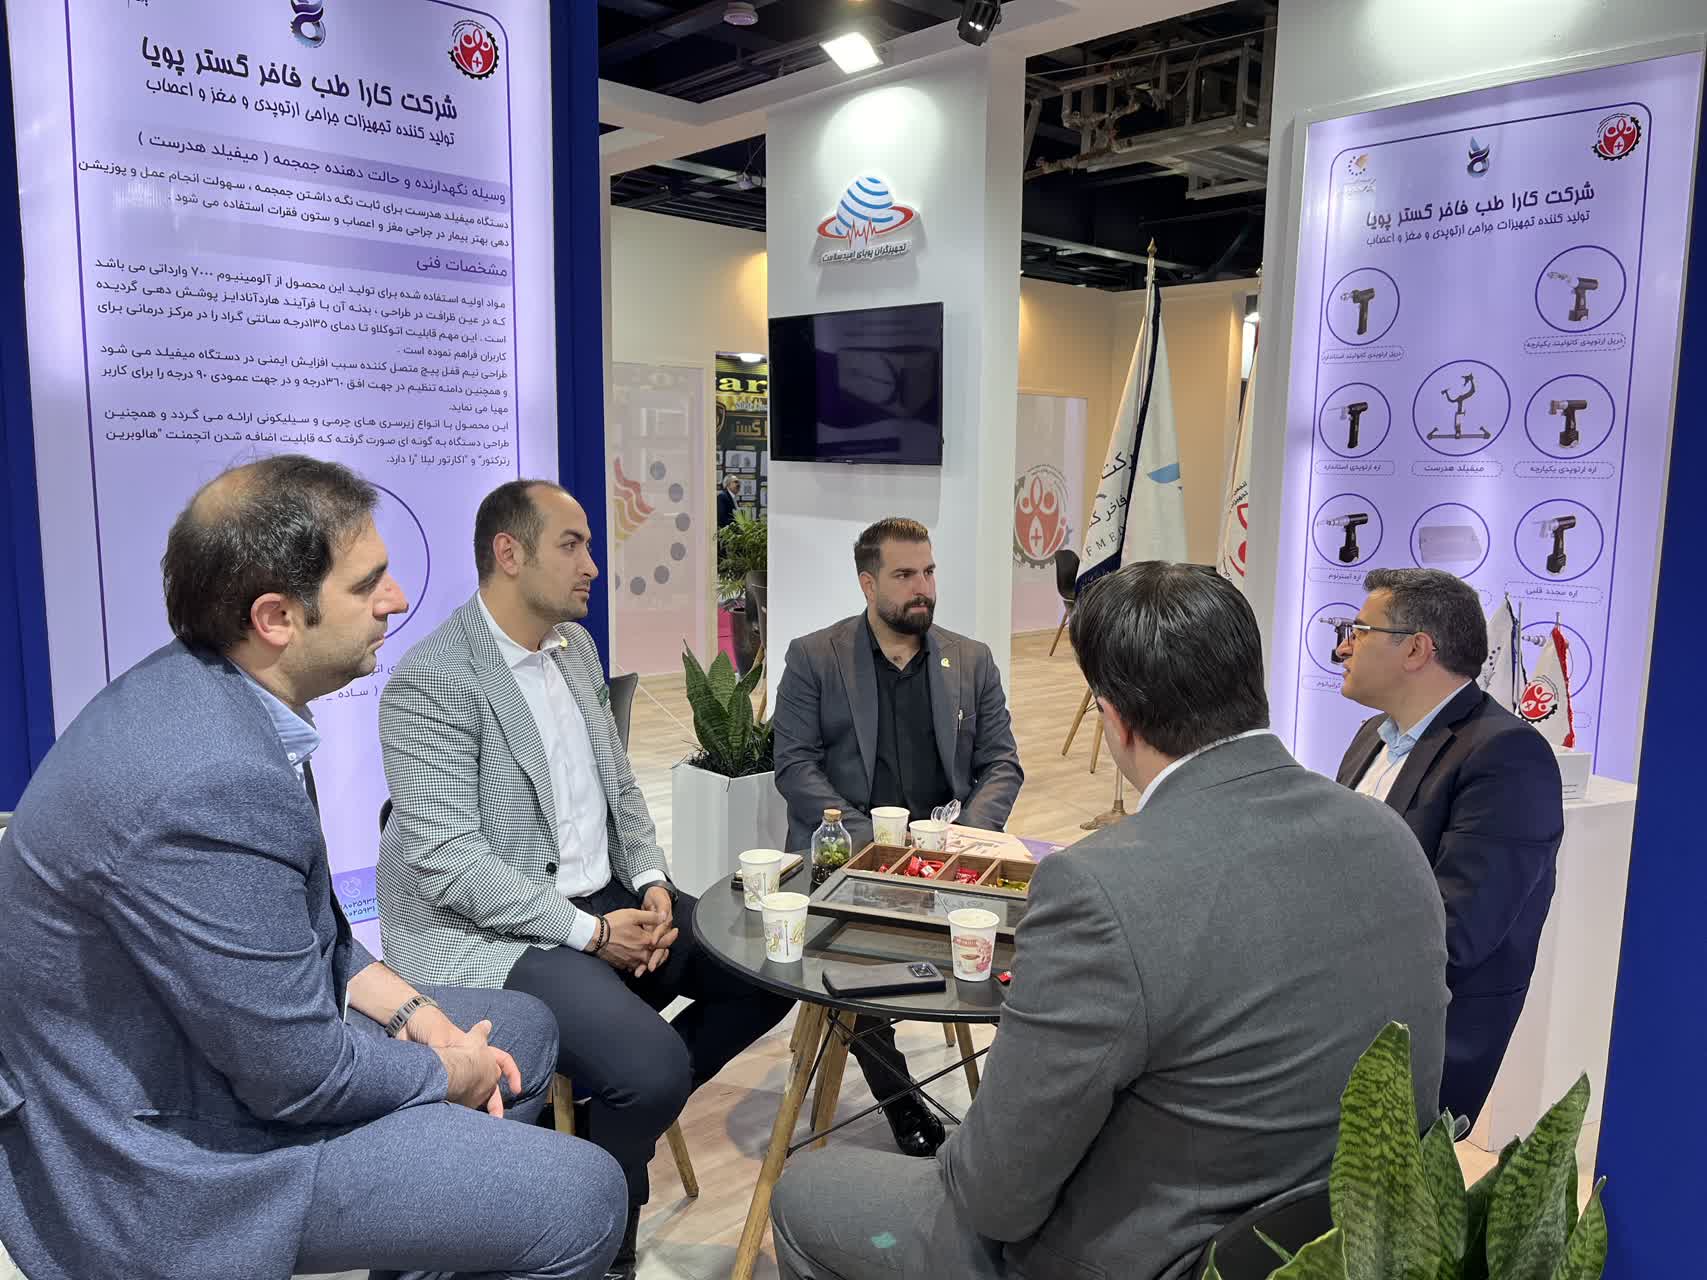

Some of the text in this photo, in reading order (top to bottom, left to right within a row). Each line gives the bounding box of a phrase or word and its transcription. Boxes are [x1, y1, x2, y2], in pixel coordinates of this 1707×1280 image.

[142, 35, 458, 121] شرکت کارا طب فاخر گستر پویا
[145, 77, 455, 147] تولید کننده تجهیزات جراحی ارتوپدی و مغز و اعصاب
[149, 136, 206, 153] هدرست
[211, 144, 258, 163] میفیلد
[273, 155, 320, 173] جمجمه
[325, 164, 363, 178] دهنده
[368, 171, 399, 183] حالت
[404, 179, 410, 189] و
[79, 160, 508, 229] دستگاه میفیلد هدرست برای ثابت نگه داشتن جمجمه سهولت انجام عمل و پوزیشن
[175, 194, 198, 205] شود
[472, 187, 505, 204] وسیله
[203, 200, 219, 208] می
[223, 200, 264, 212] استفاده
[1366, 180, 1595, 231] شرکت کارا طب فاخر گستر پویا
[268, 206, 297, 218] فقرات
[301, 212, 330, 222] ستون
[334, 217, 339, 225] و
[342, 217, 374, 228] اعصاب
[378, 224, 383, 232] و
[387, 222, 402, 232] مغز
[406, 227, 432, 238] جراحی
[1366, 210, 1591, 248] تولید کننده تجهیزات جراحی ارتوپدی و مغز و اعصاب
[448, 232, 468, 243] بیمار
[471, 235, 488, 246] بهتر
[95, 258, 124, 272] باشد
[128, 265, 145, 273] می
[416, 255, 508, 277] مشخصات فنی
[149, 264, 187, 278] وارداتی
[96, 280, 137, 293] گردیده
[275, 276, 282, 287] از
[286, 277, 325, 289] محصول
[143, 287, 171, 295] دهی
[329, 283, 344, 294] این
[348, 285, 375, 296] تولید
[378, 288, 397, 299] برای
[176, 287, 218, 302] پوشش
[400, 291, 421, 299] شده
[424, 293, 458, 303] استفاده
[283, 297, 315, 310] فرآیند
[320, 300, 329, 312] با
[333, 301, 346, 313] آن
[461, 298, 483, 308] اولیه
[487, 299, 505, 310] مواد
[349, 304, 371, 316] بدنه
[381, 308, 411, 319] طراحی
[414, 312, 423, 320] در
[426, 312, 455, 323] ظرافت
[493, 317, 506, 325] که
[481, 318, 490, 326] در
[428, 349, 451, 358] نموده
[454, 350, 477, 360] فراهم
[481, 352, 506, 363] کاربران
[105, 409, 156, 421] همچنین
[171, 408, 199, 421] گردد
[491, 404, 508, 415] مهیا
[161, 412, 166, 421] و
[227, 412, 252, 423] ارائه
[257, 413, 309, 425] سیلیکونی
[313, 418, 318, 426] و
[322, 419, 351, 428] چرمی
[354, 417, 376, 428] های
[379, 421, 414, 429] زیرسری
[417, 420, 440, 430] انواع
[444, 420, 452, 430] با
[455, 421, 489, 431] محصول
[492, 422, 508, 432] این
